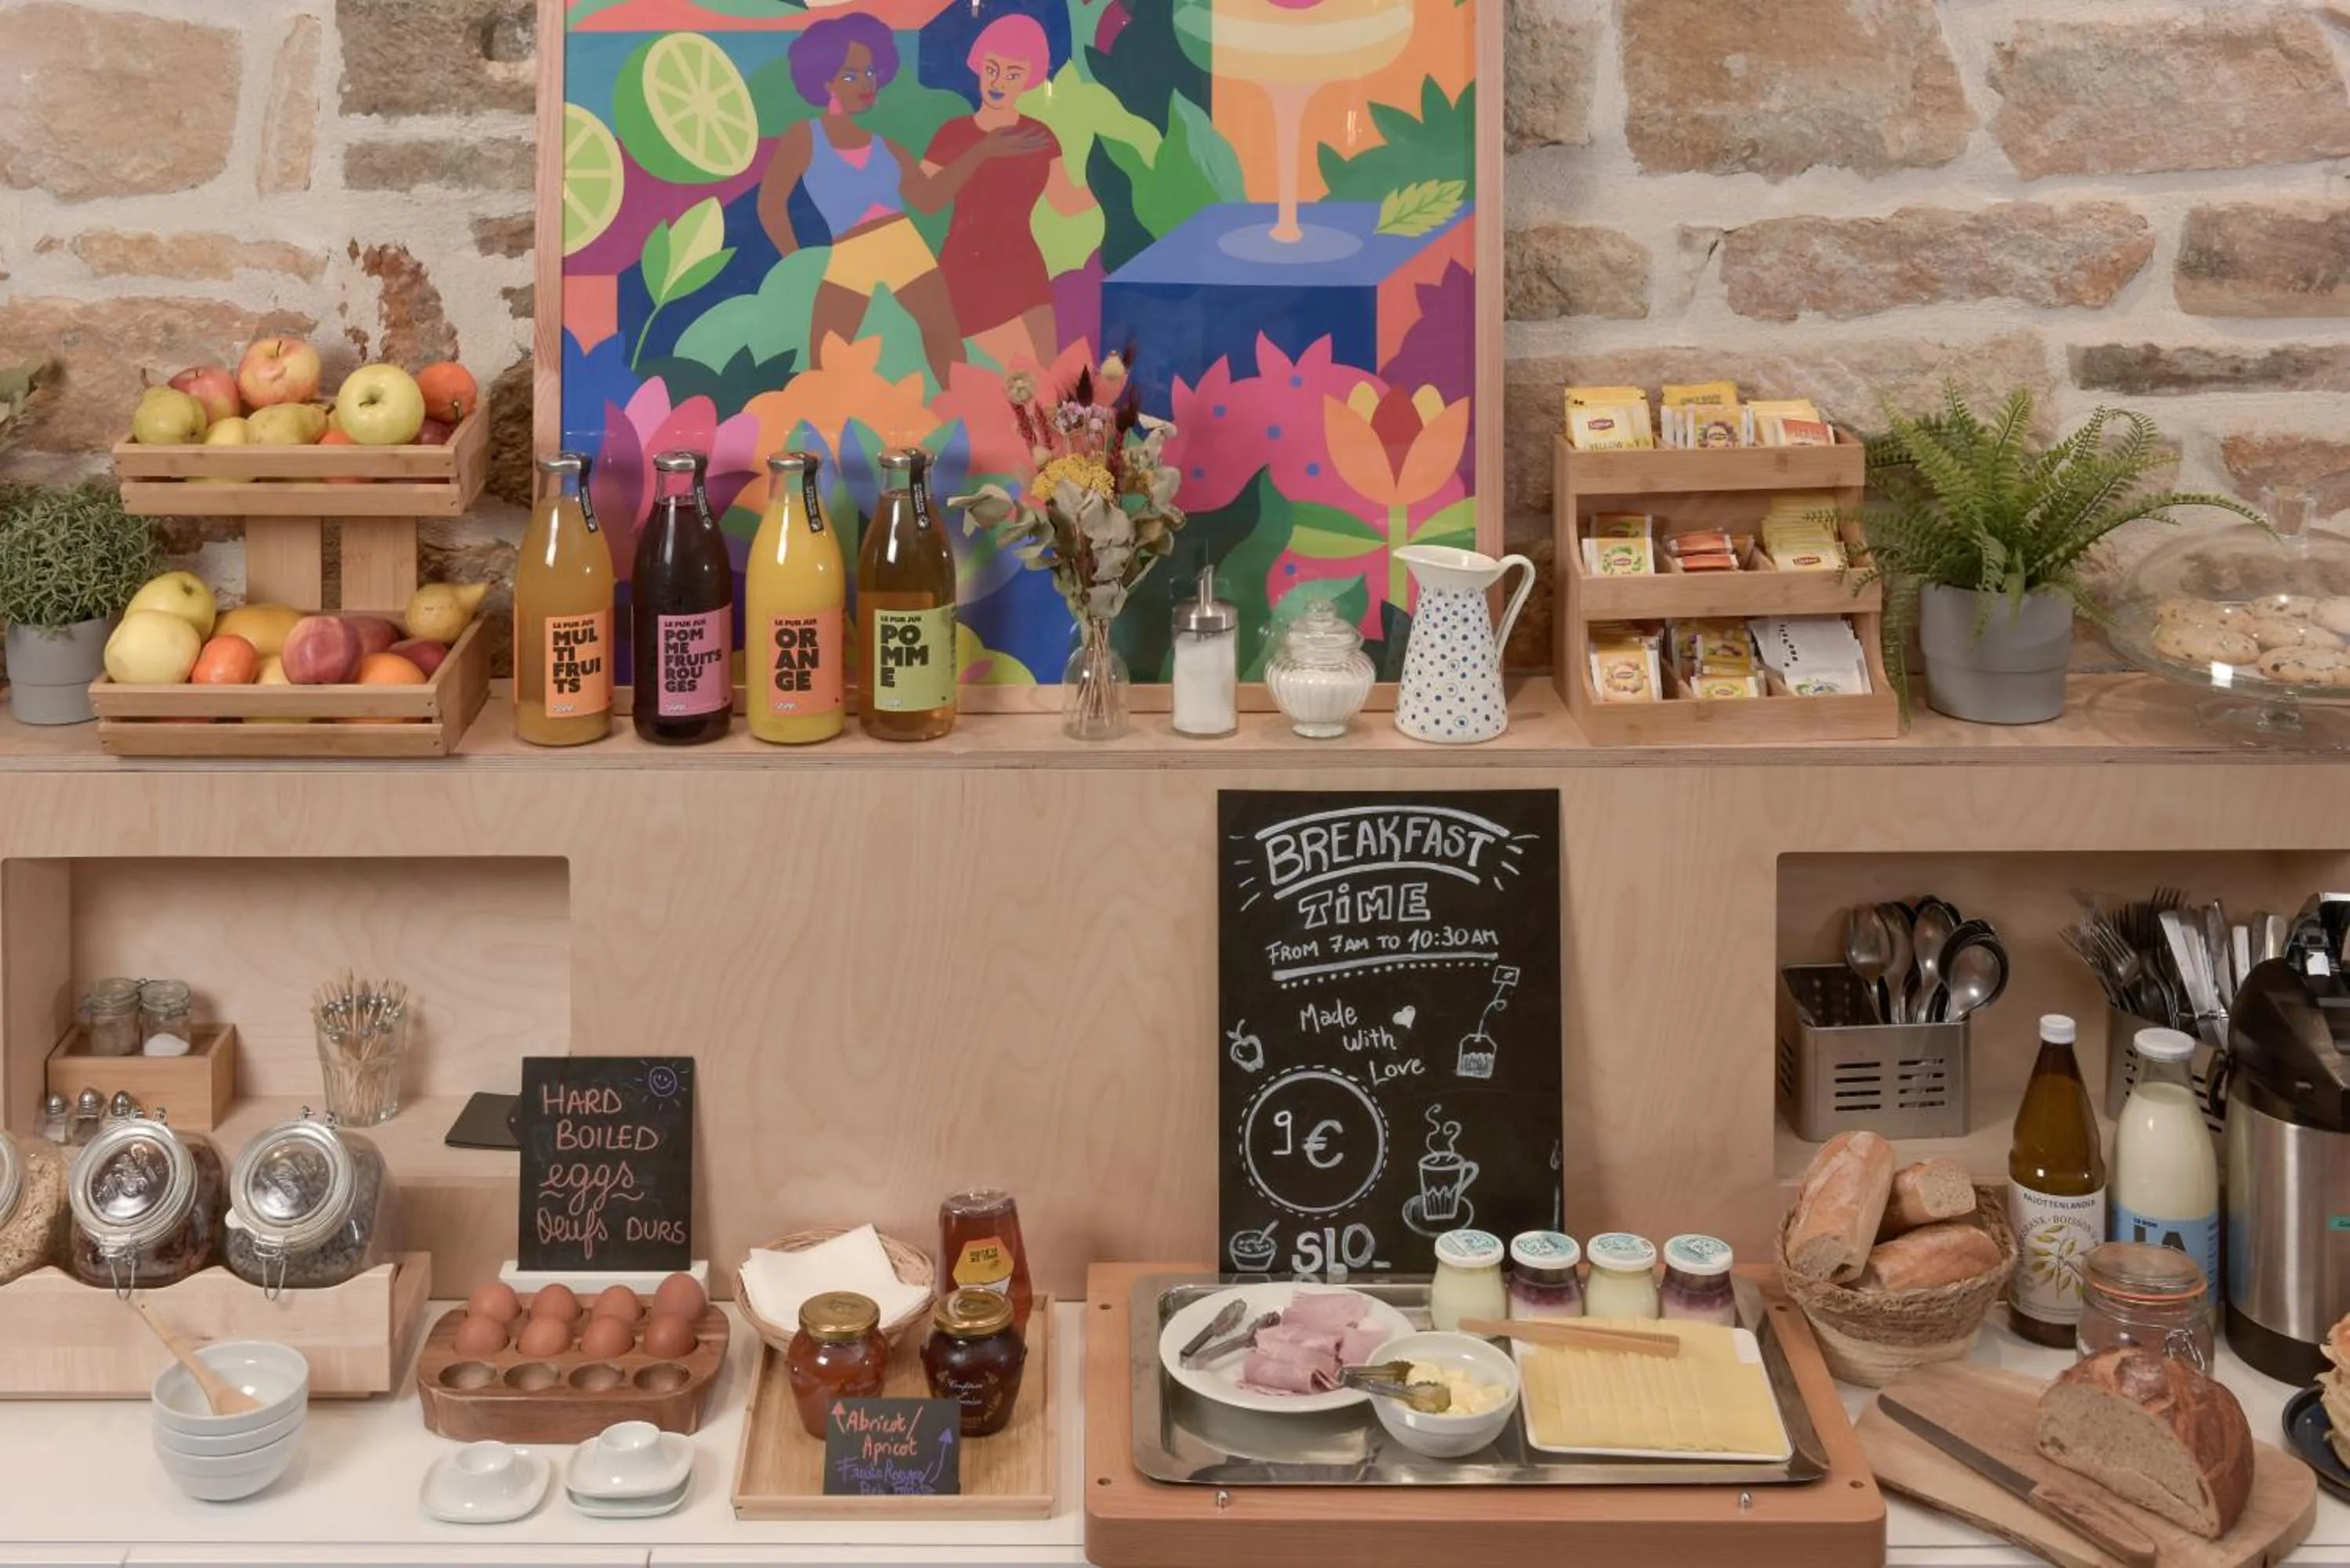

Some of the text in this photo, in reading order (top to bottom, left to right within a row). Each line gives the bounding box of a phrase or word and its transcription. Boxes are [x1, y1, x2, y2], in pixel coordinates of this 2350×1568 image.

[552, 627, 598, 646] MUL
[664, 628, 704, 641] POM
[775, 627, 819, 649] OR
[880, 624, 921, 646] PO
[552, 646, 575, 662] TI
[664, 642, 689, 654] ME
[664, 649, 722, 667] FRUITS
[880, 645, 929, 667] MM
[552, 657, 601, 677] FRUI
[775, 649, 819, 670] AN
[664, 666, 703, 680] ROU
[775, 670, 812, 692] GE
[880, 667, 895, 688] E
[552, 677, 580, 694] TS
[664, 679, 697, 692] GES
[1265, 815, 1496, 886] BREAKFAST
[1265, 940, 1319, 965] FROM
[1376, 934, 1401, 949] TO
[1300, 998, 1358, 1034] Made
[1368, 1057, 1426, 1088] Love
[541, 1084, 623, 1116] HARD
[555, 1118, 660, 1152] BOILED
[539, 1160, 634, 1216] eggs
[626, 1216, 687, 1245] DURS
